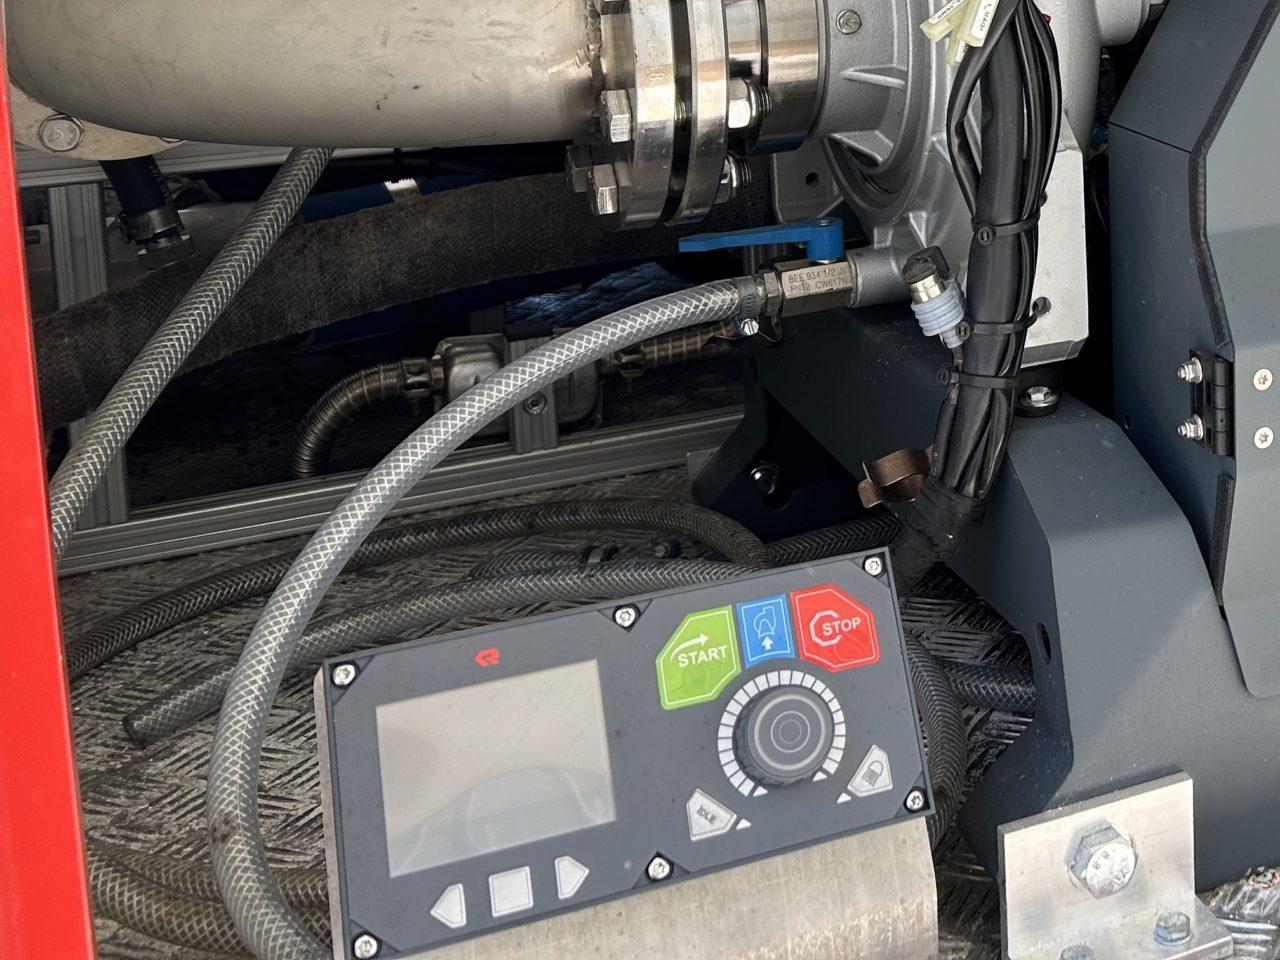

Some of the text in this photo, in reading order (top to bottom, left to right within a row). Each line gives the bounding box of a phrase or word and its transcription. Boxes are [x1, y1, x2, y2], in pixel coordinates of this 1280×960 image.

[806, 271, 820, 280] 934
[823, 268, 836, 277] 1/2
[822, 617, 861, 637] STOP
[677, 645, 728, 668] START
[696, 805, 717, 824] IDLE
